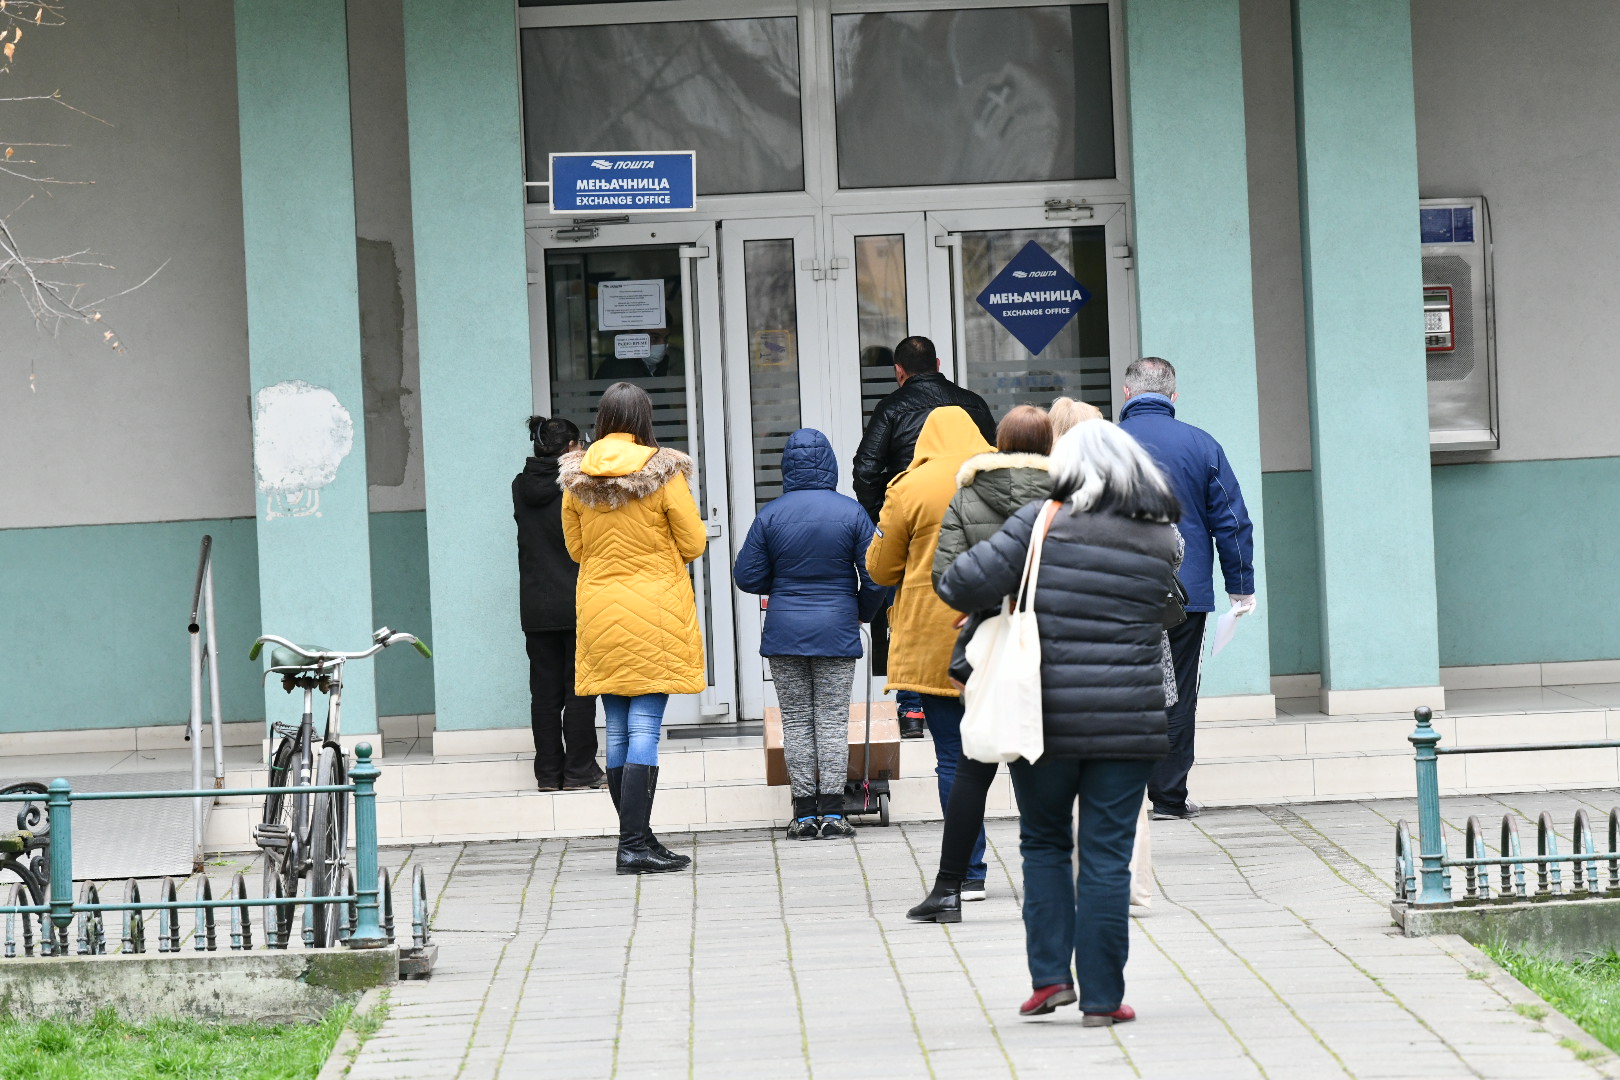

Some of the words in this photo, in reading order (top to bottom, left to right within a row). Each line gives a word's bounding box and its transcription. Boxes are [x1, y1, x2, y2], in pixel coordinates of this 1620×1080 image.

[614, 161, 654, 170] ПОШТА
[576, 178, 670, 191] МЕЊАЧНИЦА
[576, 196, 633, 206] EXCHANGE
[635, 195, 671, 205] OFFICE
[1028, 270, 1057, 278] ПОШТА
[989, 289, 1082, 305] МЕЊАЧНИЦА
[1002, 308, 1043, 317] EXCHANGE
[1045, 307, 1070, 315] OFFICE
